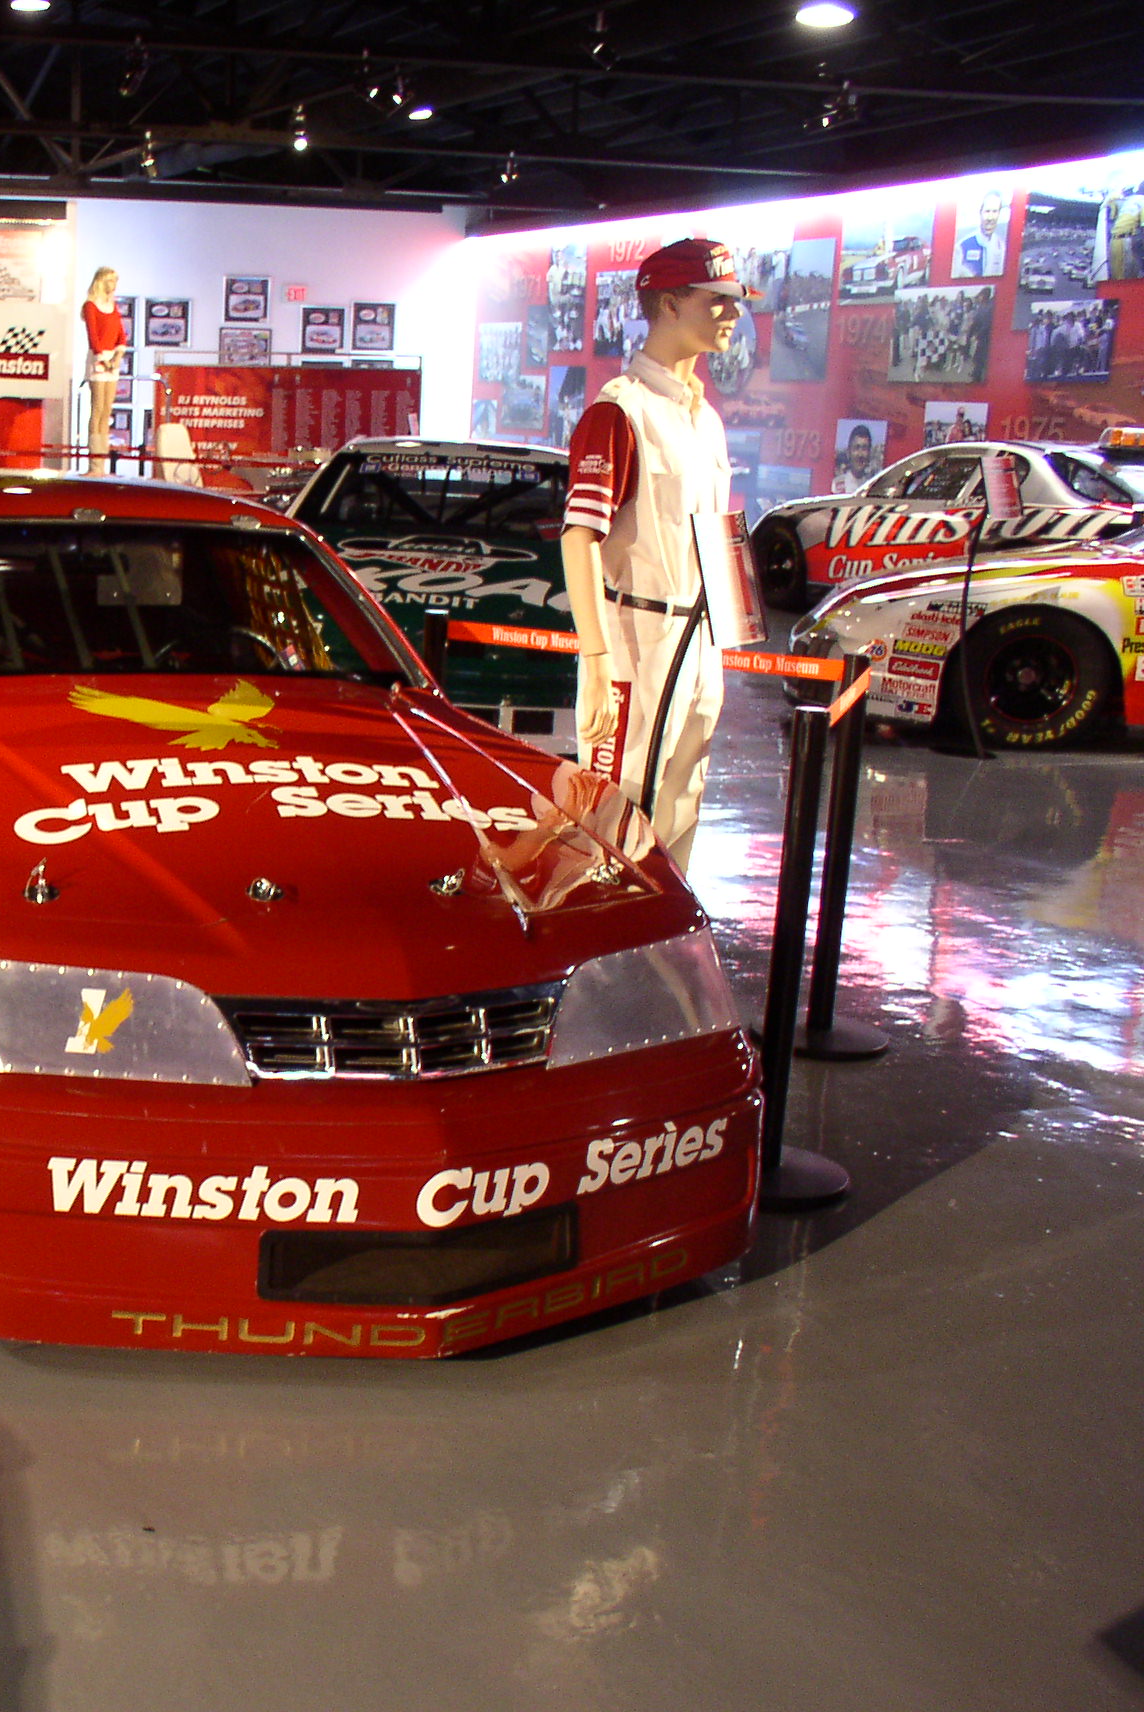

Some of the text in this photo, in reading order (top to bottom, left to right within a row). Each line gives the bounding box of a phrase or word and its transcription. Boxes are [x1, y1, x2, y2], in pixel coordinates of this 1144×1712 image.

[608, 238, 644, 262] 1972
[287, 286, 307, 300] EXIT
[837, 314, 891, 344] 1974
[177, 394, 247, 406] RJ REYNOLDS
[179, 418, 245, 429] ENTERPRISES
[201, 406, 264, 418] MARKETING
[1001, 415, 1065, 442] 1975
[774, 431, 822, 459] 1973
[366, 454, 536, 472] Cutlass Supreme
[492, 627, 581, 651] Winston Cup Museu
[905, 626, 952, 643] SIMPSON
[894, 640, 947, 657] MOOG
[752, 653, 773, 673] Cup
[775, 658, 820, 676] Museum
[882, 677, 936, 695] Motorcraft
[896, 699, 933, 716] JE
[61, 756, 440, 793] Winston
[13, 786, 539, 845] Cup Series
[47, 1113, 729, 1228] Winston Cup Series
[111, 1246, 691, 1348] THUNDERBIRD
